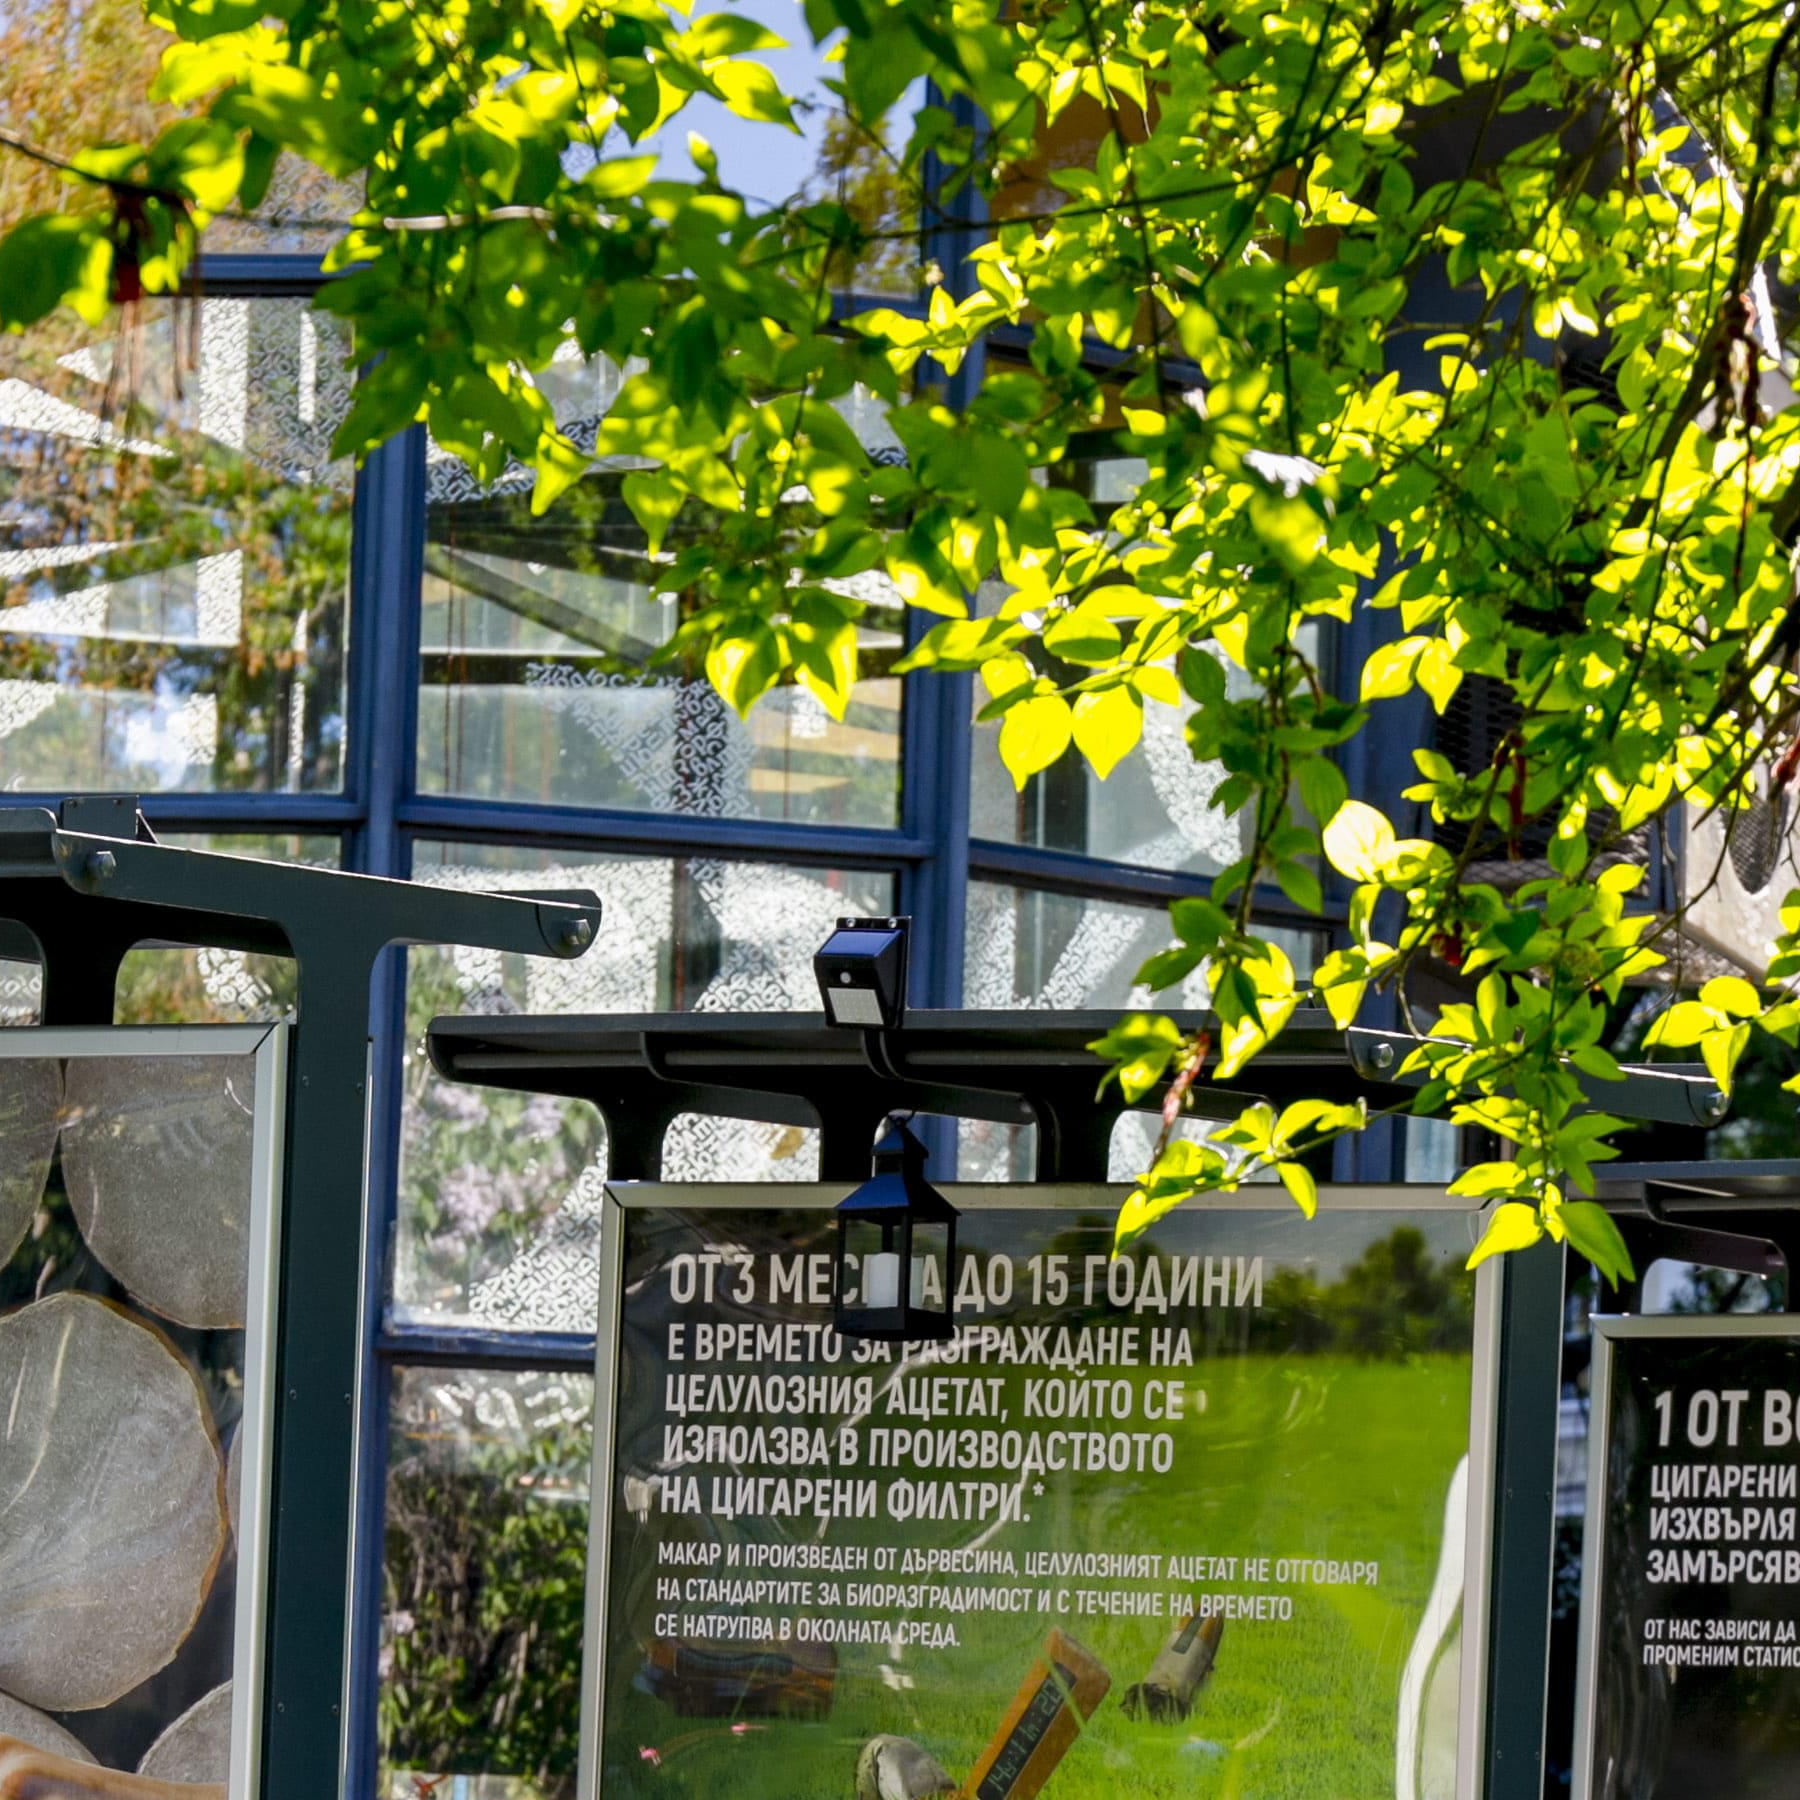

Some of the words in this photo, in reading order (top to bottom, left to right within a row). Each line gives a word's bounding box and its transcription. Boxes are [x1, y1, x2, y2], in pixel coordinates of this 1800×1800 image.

[670, 1253, 721, 1304] ОТ
[732, 1253, 755, 1304] 3
[953, 1253, 1013, 1314] ДО
[1027, 1254, 1069, 1305] 15
[1084, 1254, 1263, 1315] ГОДИНИ
[668, 1323, 685, 1361] Е
[695, 1323, 842, 1363] ВРЕМЕТО
[852, 1337, 891, 1363] ЗА
[902, 1326, 1140, 1371] РАЗГРАЖДАНЕ
[1150, 1327, 1194, 1366] НА
[665, 1374, 873, 1418] ЦЕЛУЛОЗНИЯ
[886, 1377, 1008, 1423] АЦЕТАТ,
[1024, 1369, 1132, 1418] КОЙТО
[1144, 1380, 1184, 1420] СЕ
[1655, 1390, 1672, 1447] 1
[1687, 1389, 1750, 1447] ОТ
[663, 1425, 829, 1466] ИЗПОЛЗВА
[839, 1428, 858, 1466] В
[869, 1428, 1174, 1475] ПРОИЗВОДСТВОТО
[661, 1476, 701, 1514] НА
[711, 1477, 877, 1520] ЦИГАРЕНИ
[1651, 1464, 1797, 1502] ЦИГАРЕНИ
[1650, 1507, 1796, 1541] ИЗХВЪРЛЯ
[658, 1541, 722, 1566] МАКАР
[727, 1544, 741, 1567] И
[745, 1544, 868, 1573] ПРОИЗВЕДЕН
[874, 1547, 897, 1571] ОТ
[901, 1548, 1019, 1578] ДЪРВЕСИНА,
[1025, 1552, 1162, 1580] ЦЕЛУЛОЗНИЯТ
[1167, 1555, 1237, 1584] АЦЕТАТ
[1244, 1557, 1270, 1582] НЕ
[1275, 1559, 1379, 1586] ОТГОВАРЯ
[656, 1577, 681, 1600] НА
[685, 1578, 812, 1606] СТАНДАРТИТЕ
[818, 1583, 841, 1606] ЗА
[846, 1583, 1032, 1612] БИОРАЗГРАДИМОСТ
[1036, 1589, 1050, 1612] И
[1057, 1590, 1070, 1613] С
[1077, 1591, 1163, 1616] ТЕЧЕНИЕ
[1170, 1593, 1195, 1617] НА
[1200, 1594, 1293, 1621] ВРЕМЕТО
[654, 1613, 677, 1637] СЕ
[683, 1614, 774, 1641] НАТРУПВА
[780, 1618, 792, 1641] В
[797, 1619, 893, 1645] ОКОЛНАТА
[898, 1622, 961, 1649] СРЕДА.
[1644, 1618, 1665, 1640] ОТ
[1669, 1619, 1701, 1640] НАС
[1704, 1619, 1771, 1641] ЗАВИСИ
[1774, 1620, 1796, 1643] ДА
[1643, 1645, 1739, 1667] ПРОМЕНИМ
